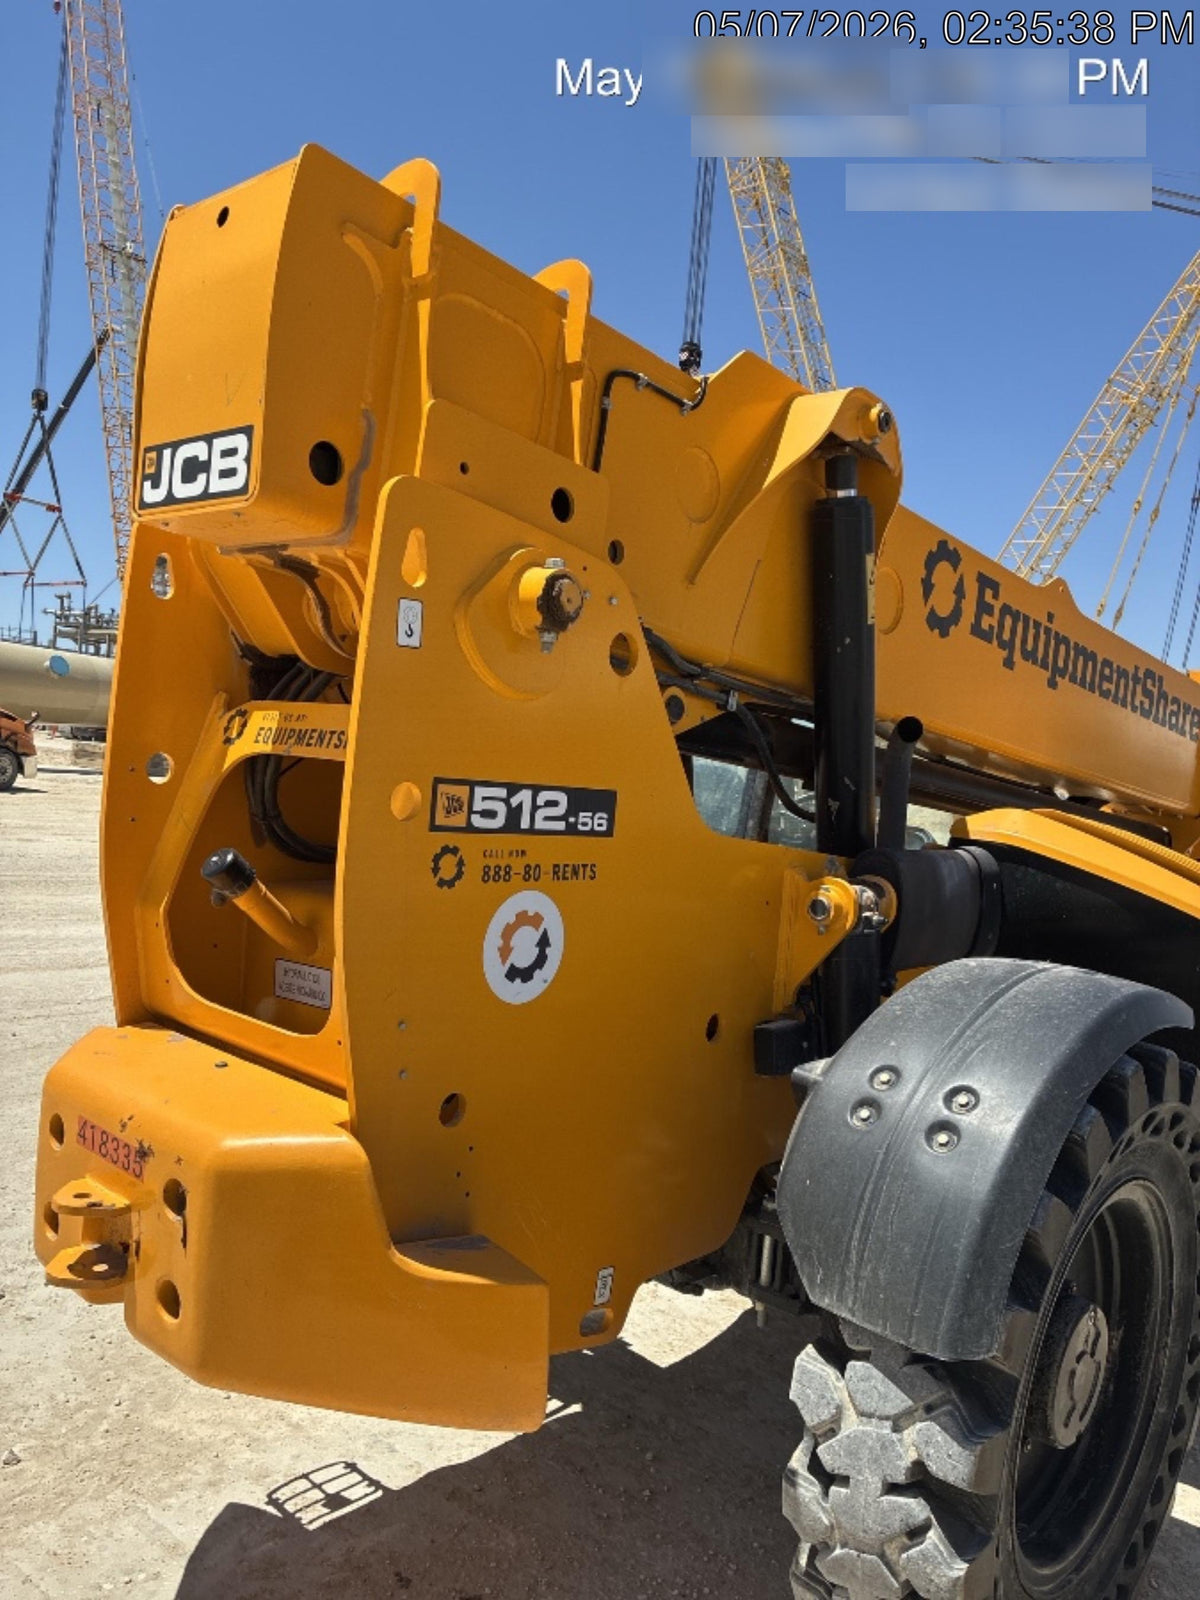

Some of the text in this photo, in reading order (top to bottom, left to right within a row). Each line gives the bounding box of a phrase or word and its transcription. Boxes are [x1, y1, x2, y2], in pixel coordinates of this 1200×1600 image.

[143, 433, 249, 503] JCB
[971, 571, 1200, 743] EquipmentShare
[254, 727, 347, 749] EQUIPMENTS
[78, 1120, 144, 1178] 418335
